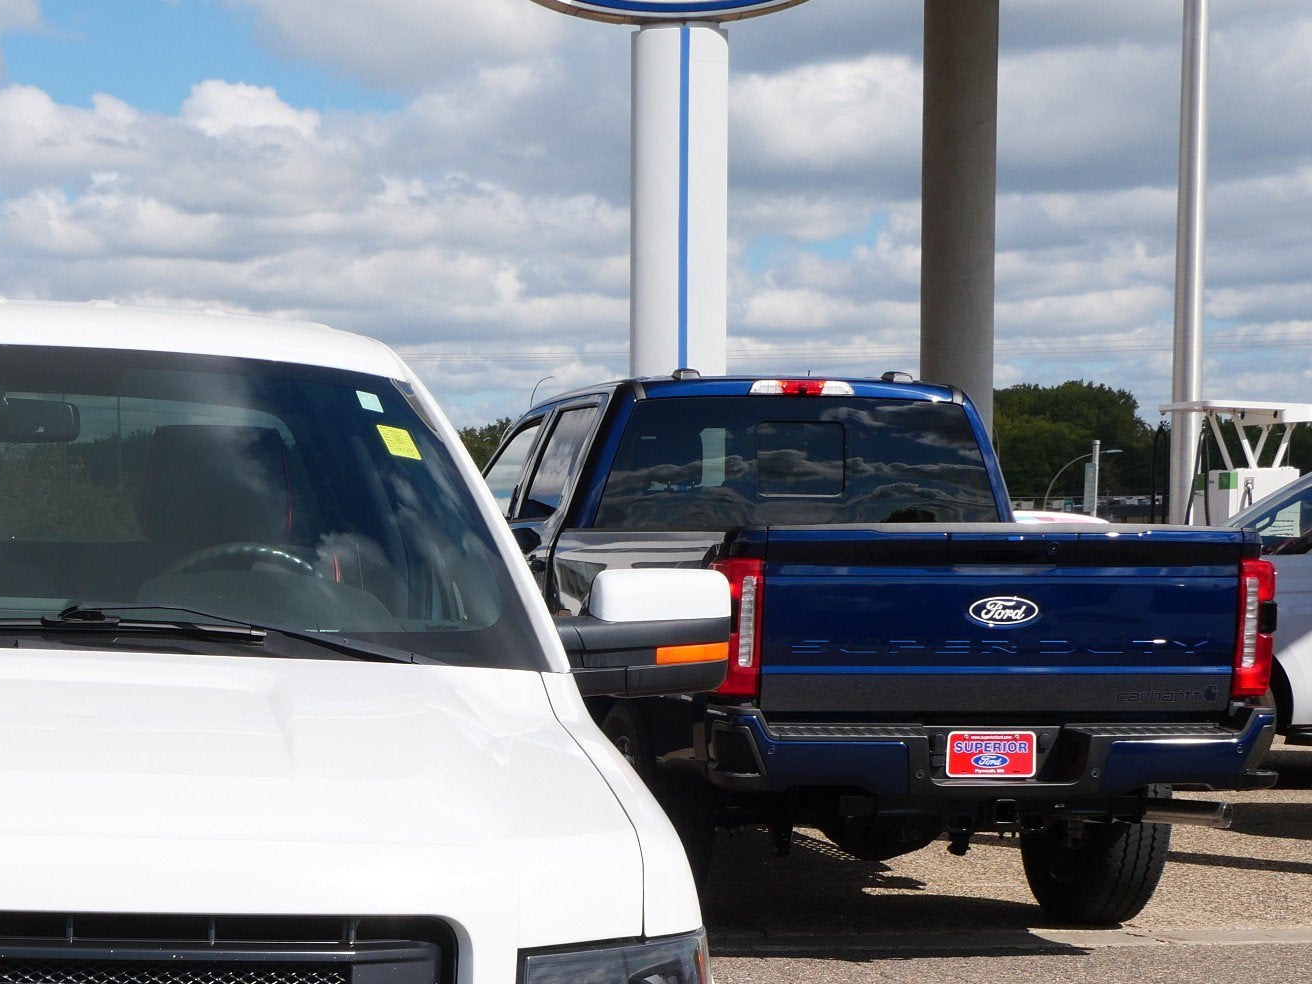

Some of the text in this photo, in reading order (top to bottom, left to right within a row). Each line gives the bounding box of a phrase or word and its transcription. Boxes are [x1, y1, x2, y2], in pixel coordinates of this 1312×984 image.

[981, 600, 1027, 620] Ford
[791, 639, 1209, 655] SUPER DUTY
[1116, 690, 1201, 702] carhartt
[954, 741, 1029, 754] SUPERIOR
[978, 755, 1003, 766] Ford
